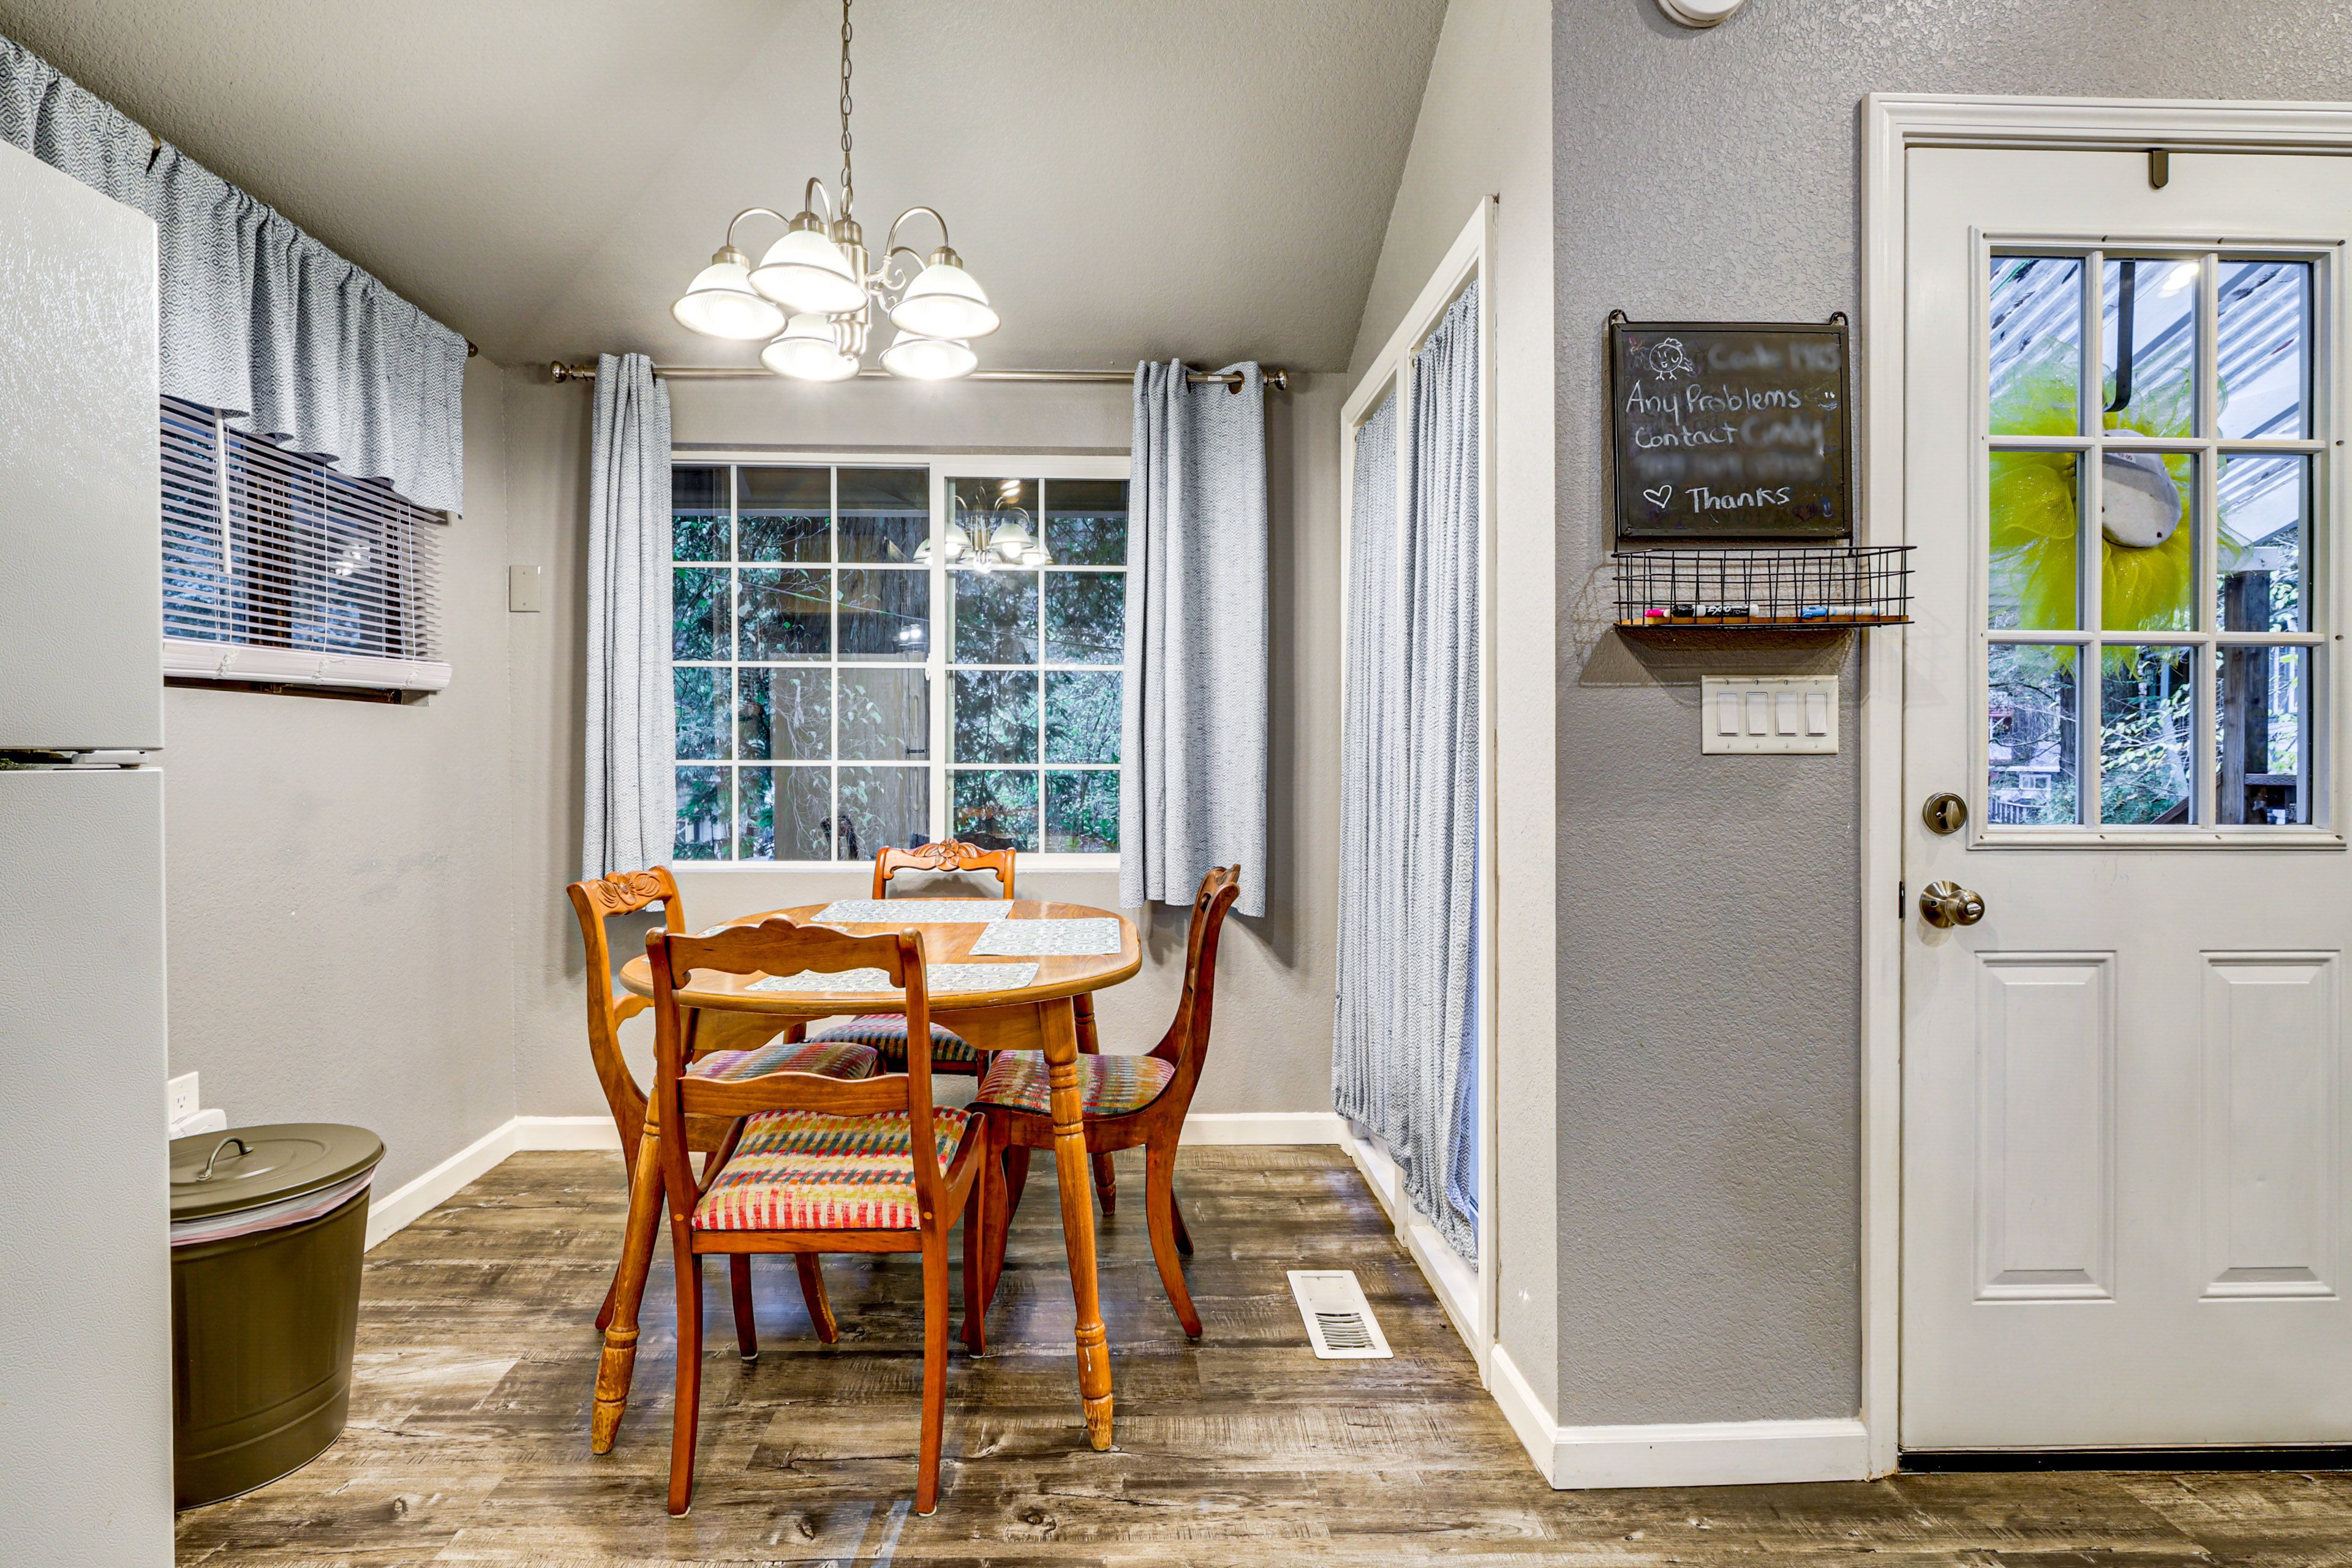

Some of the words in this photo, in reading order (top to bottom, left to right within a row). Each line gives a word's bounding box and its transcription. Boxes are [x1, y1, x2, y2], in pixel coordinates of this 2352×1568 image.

[1626, 379, 1680, 426] Any
[1686, 383, 1802, 413] Problems
[1635, 420, 1738, 448] Contact
[1684, 487, 1792, 513] Thanks
